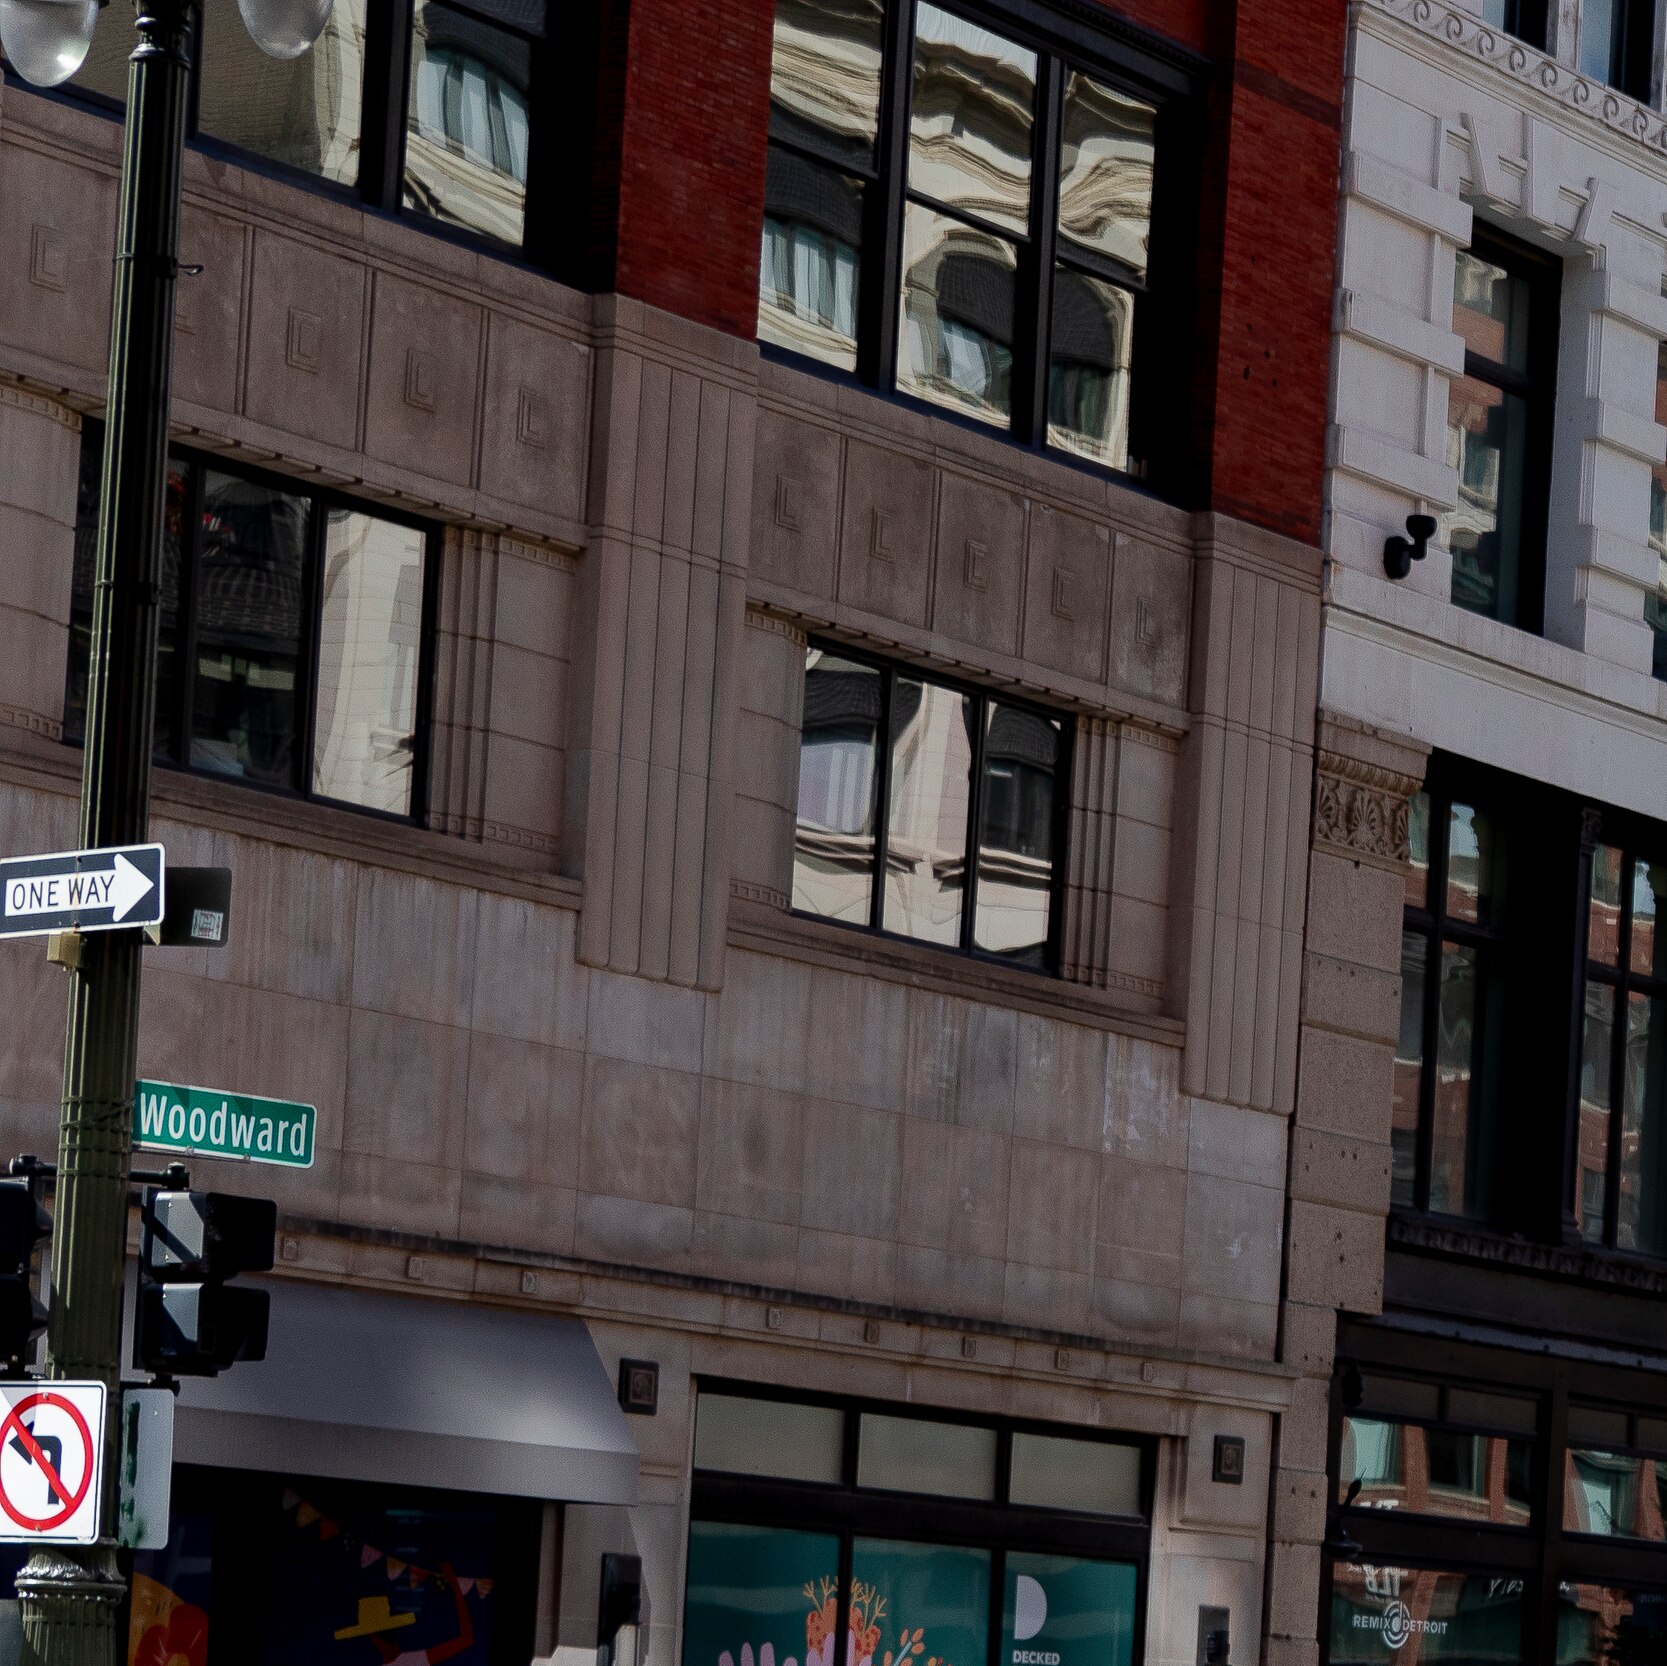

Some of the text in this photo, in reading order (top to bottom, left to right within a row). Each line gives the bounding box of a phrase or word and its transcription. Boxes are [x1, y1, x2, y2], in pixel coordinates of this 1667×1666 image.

[12, 874, 115, 910] ONE WAY
[140, 1092, 308, 1157] Woodward
[1352, 1613, 1448, 1635] REMIX DETROIT
[1011, 1649, 1061, 1666] DECKED
